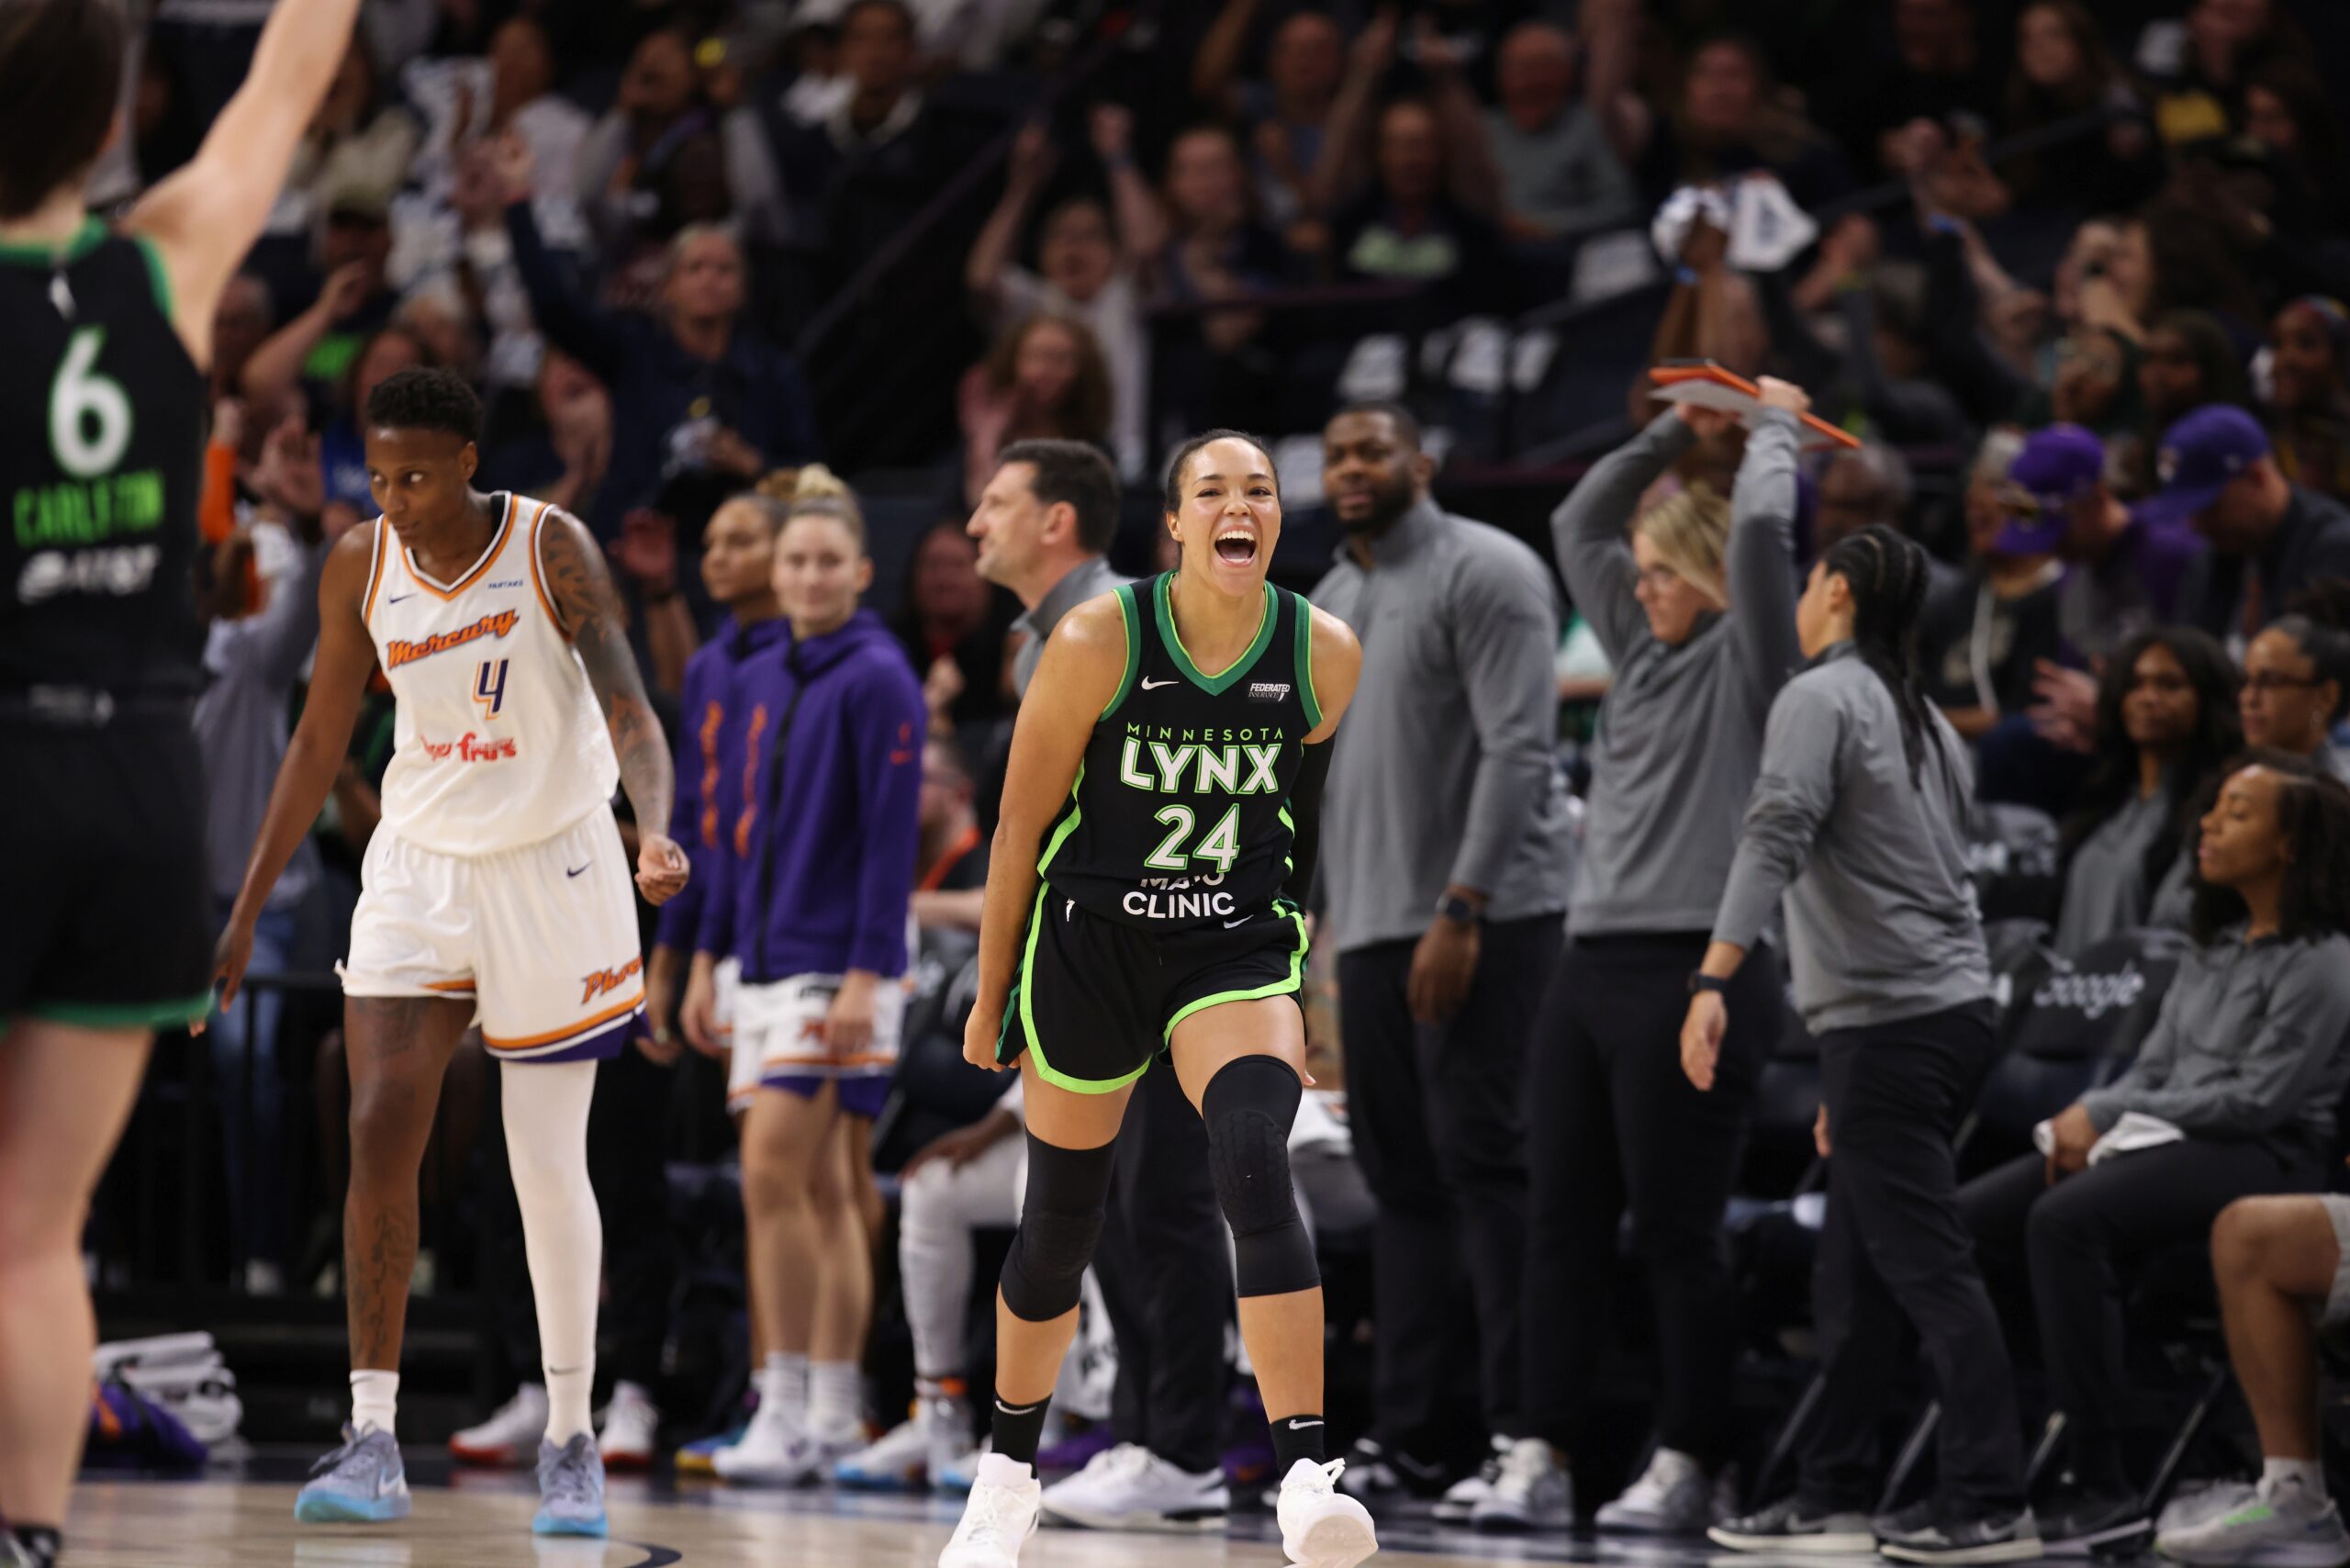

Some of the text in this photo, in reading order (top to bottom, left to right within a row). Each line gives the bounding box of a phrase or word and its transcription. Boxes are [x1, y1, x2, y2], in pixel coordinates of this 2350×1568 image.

[50, 325, 133, 478] 6
[386, 609, 520, 671] Mercury
[474, 658, 509, 721] 4
[1249, 682, 1291, 693] FEDERATED
[1127, 722, 1283, 741] MINNESOTA
[1121, 736, 1282, 795] LYNX
[1144, 803, 1240, 874] 24
[1123, 890, 1236, 919] CLINIC
[1140, 872, 1225, 890] MAO
